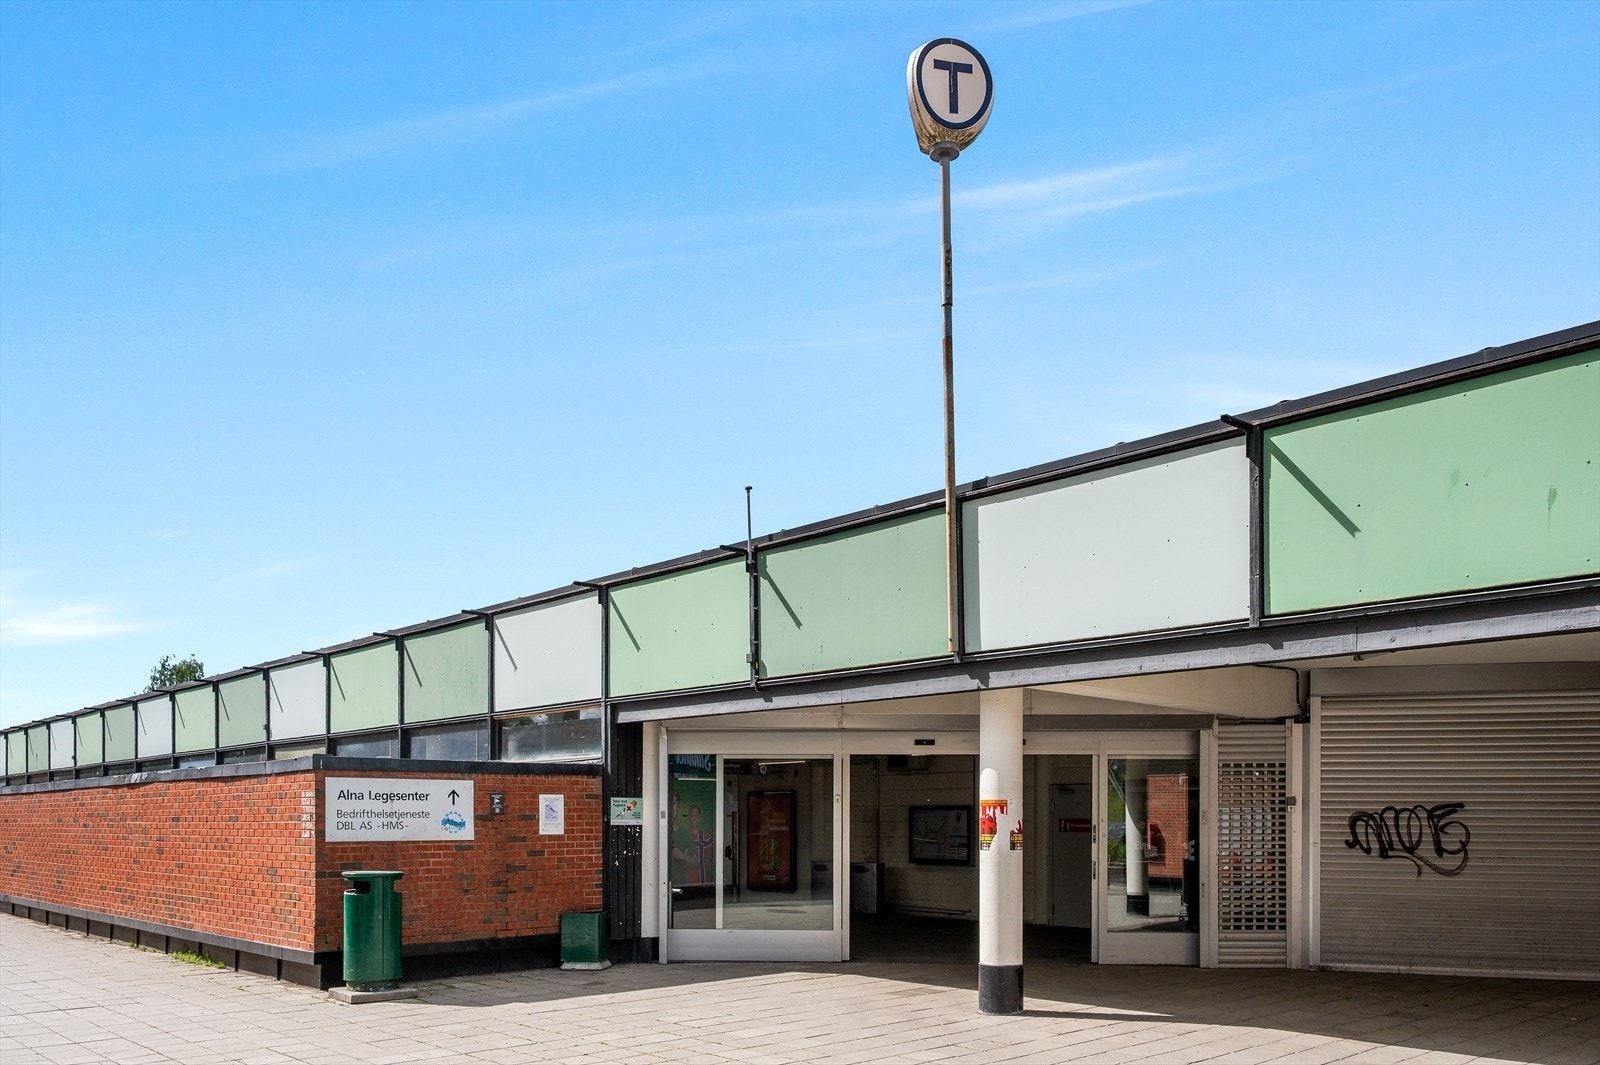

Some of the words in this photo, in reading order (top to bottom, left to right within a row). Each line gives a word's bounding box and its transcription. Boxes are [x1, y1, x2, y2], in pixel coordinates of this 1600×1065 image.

[934, 59, 973, 114] T
[337, 789, 364, 801] Alna
[368, 790, 430, 803] Legesenter
[336, 809, 430, 821] Bedrifthelsetjeneste
[336, 820, 356, 831] DBL
[359, 820, 373, 831] AS
